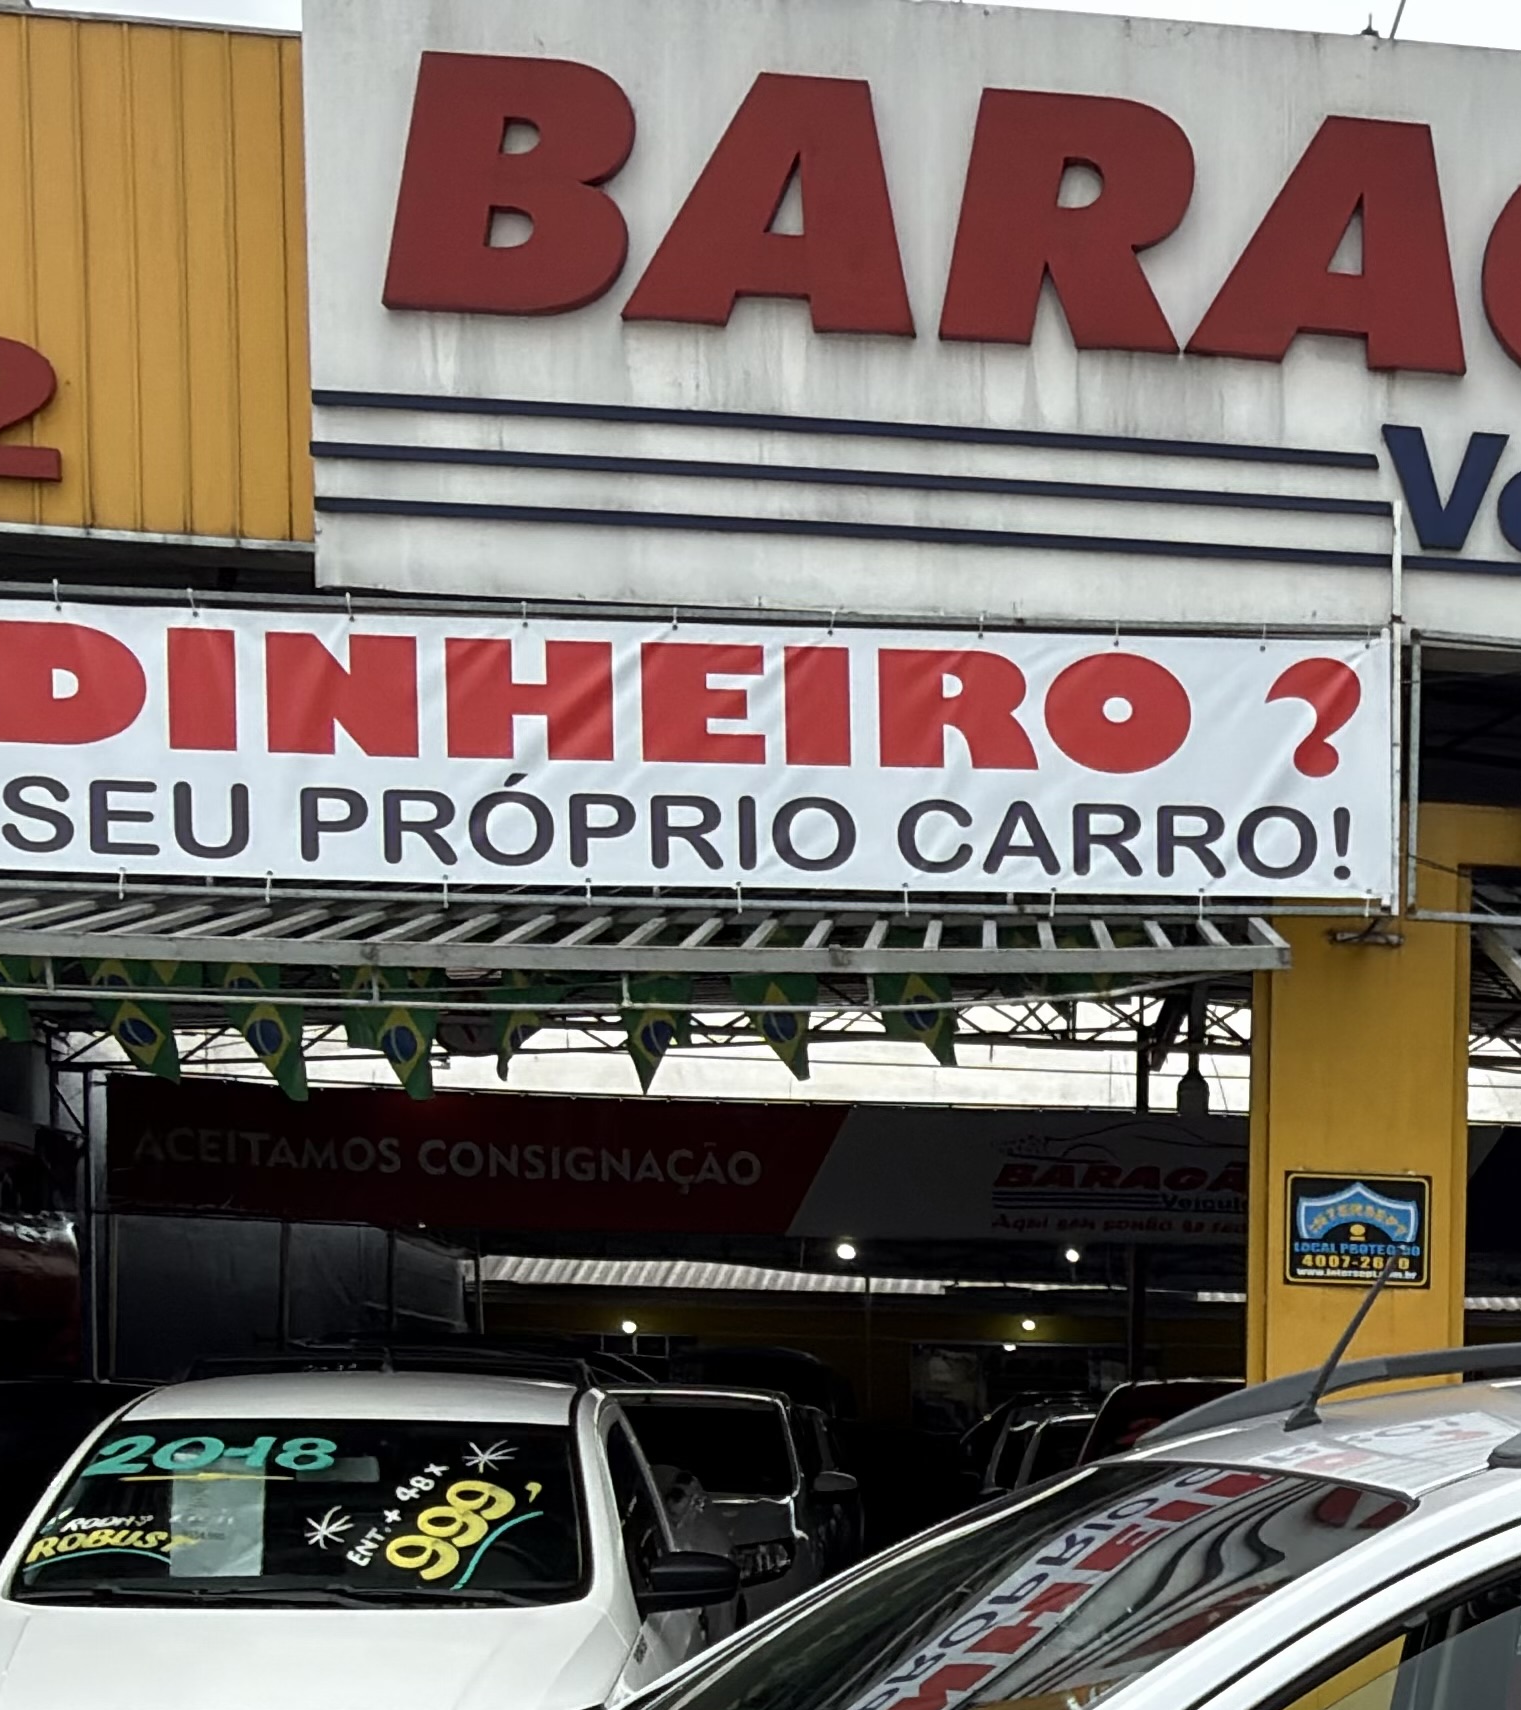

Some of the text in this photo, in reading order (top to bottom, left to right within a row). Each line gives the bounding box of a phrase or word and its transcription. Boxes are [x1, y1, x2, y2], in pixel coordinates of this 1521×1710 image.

[1266, 656, 1362, 778] ?
[1, 775, 250, 859] SEU
[300, 773, 857, 872] PRÓPRIO
[896, 798, 1352, 881] CARRO!
[134, 1128, 763, 1195] ACEITAMOS CONSIGNAÇÃO
[1293, 1242, 1421, 1257] LOCAL PROTEGDO
[1301, 1253, 1410, 1270] 4007-260
[80, 1435, 338, 1477] 2018
